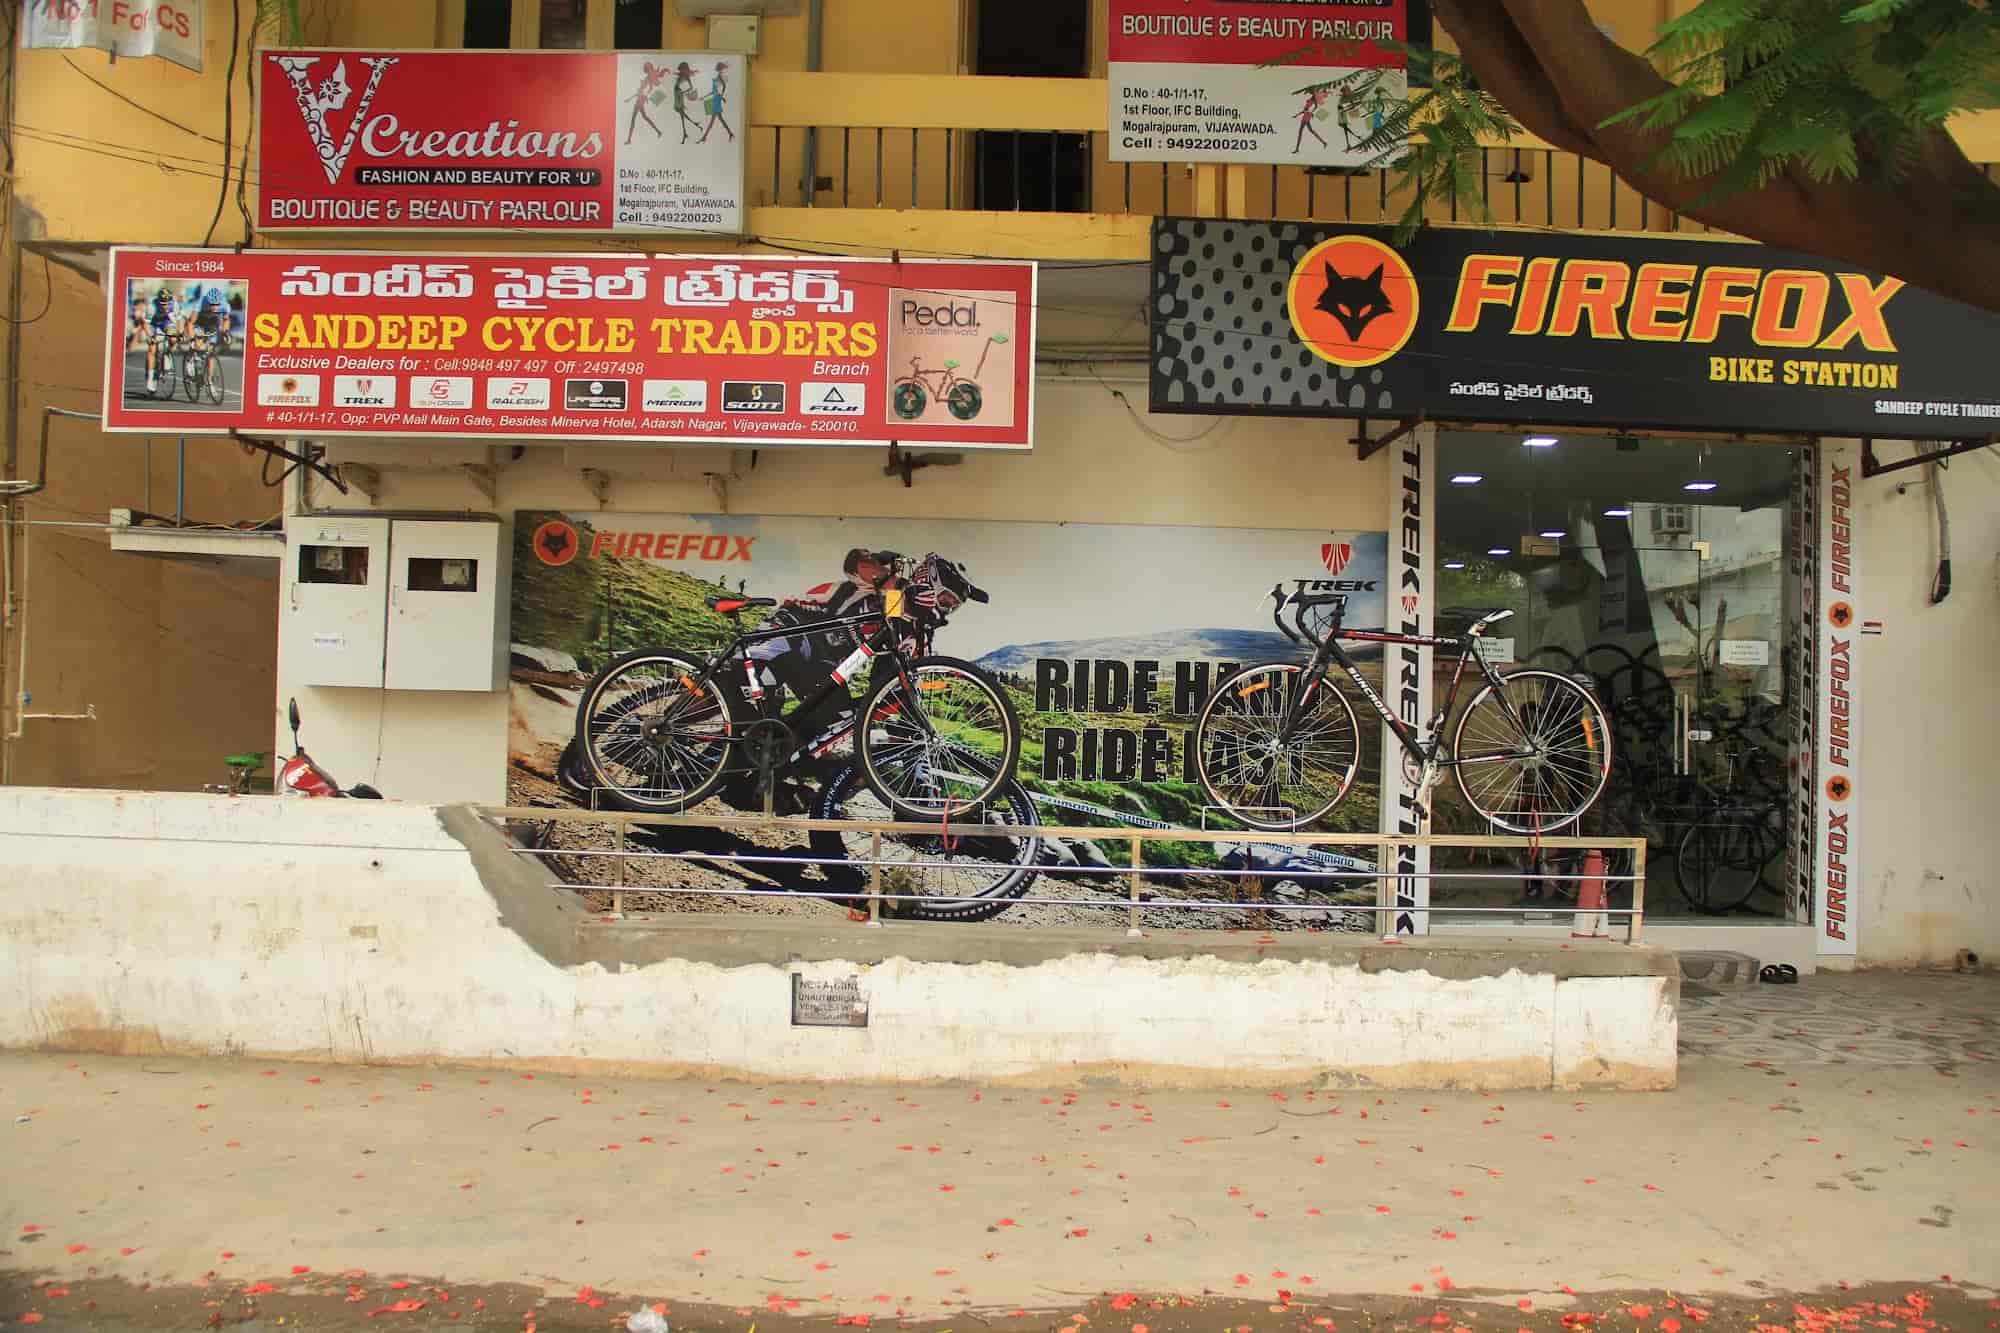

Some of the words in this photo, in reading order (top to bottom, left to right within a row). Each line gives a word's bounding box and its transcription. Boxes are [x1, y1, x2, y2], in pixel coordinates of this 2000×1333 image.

[157, 4, 190, 38] CS
[1122, 15, 1214, 36] BOUTIQUE
[1219, 16, 1232, 36] &
[1237, 17, 1307, 38] BEAUTY
[1312, 19, 1393, 40] PARLOUR
[1123, 88, 1148, 98] D.No
[1123, 104, 1139, 115] 1st
[1142, 105, 1171, 117] Floor,
[1173, 105, 1192, 116] IFC
[1195, 105, 1241, 119] Building,
[360, 113, 603, 159] Creations
[1205, 124, 1277, 135] VIJAYAWADA.
[1122, 137, 1152, 149] Cell
[1166, 138, 1258, 151] 9492200203
[361, 170, 430, 184] FASHION
[434, 171, 467, 184] AND
[471, 171, 534, 185] BEAUTY
[538, 171, 571, 185] FOR
[270, 198, 380, 220] BOUTIQUE
[386, 199, 402, 220] &
[409, 199, 494, 221] BEAUTY
[500, 200, 600, 221] PARLOUR
[619, 212, 642, 222] Cell
[652, 212, 722, 223] 9492200203
[902, 300, 981, 327] Pedal.
[1443, 254, 1908, 352] FIREFOX
[253, 312, 468, 351] SANDEEP
[481, 316, 636, 353] CYCLE
[650, 318, 878, 358] TRADERS
[257, 354, 330, 369] Exclusive
[335, 355, 394, 370] Dealers
[399, 356, 421, 371] for
[497, 359, 521, 371] 497
[524, 360, 548, 372] 497
[813, 360, 870, 376] Branch
[1709, 356, 1775, 384] BIKE
[1783, 359, 1899, 389] STATION
[344, 397, 385, 405] TREK
[646, 399, 704, 409] MERIDA
[725, 401, 783, 410] SCOTT
[809, 404, 859, 412] FUJI
[1874, 400, 1924, 415] SANDEEP
[1925, 402, 1960, 417] CYCLE
[373, 413, 400, 424] PVP
[402, 414, 428, 425] Mall
[431, 414, 460, 426] Main
[500, 416, 548, 427] Besides
[552, 416, 599, 428] Minerva
[602, 417, 637, 429] Hotel,
[640, 418, 684, 430] Adarsh
[688, 419, 728, 432] Nagar,
[1402, 443, 1421, 594] TREK
[1831, 458, 1850, 594] FIREFOX
[587, 531, 760, 562] FIREFOX
[1292, 579, 1380, 592] TREK
[1034, 659, 1160, 714] RIDE
[1400, 614, 1420, 768] TRE
[1830, 635, 1850, 768] FIREFOX
[1042, 727, 1169, 784] RIDE
[1307, 849, 1355, 868] SHIMANO
[1826, 808, 1849, 941] FIREFOX
